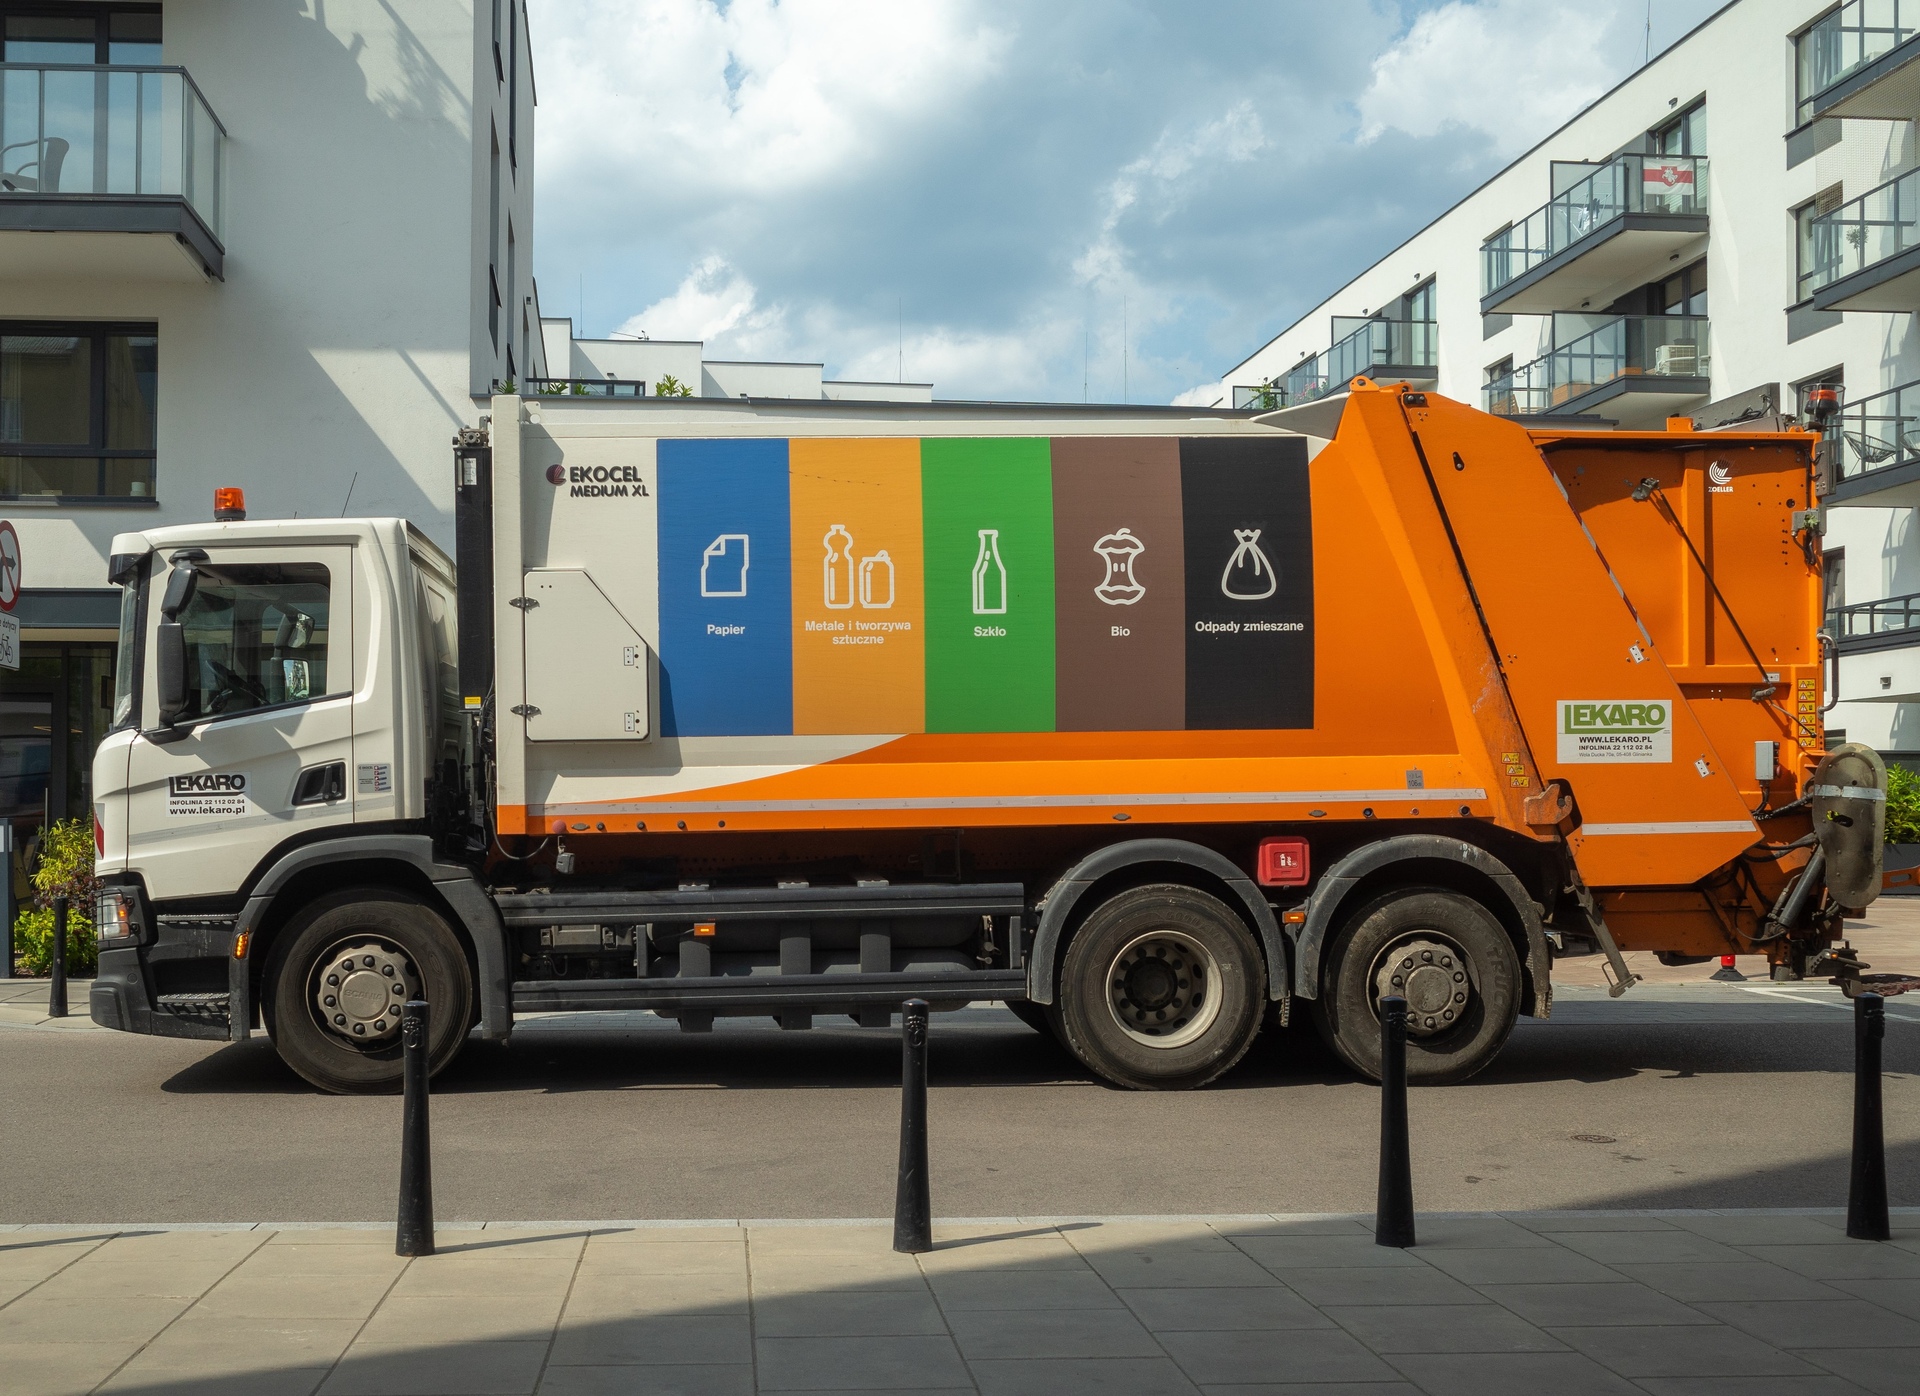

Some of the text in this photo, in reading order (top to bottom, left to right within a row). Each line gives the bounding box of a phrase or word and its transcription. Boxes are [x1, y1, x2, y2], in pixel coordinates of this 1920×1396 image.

[569, 466, 643, 483] EKOCEL
[570, 484, 650, 498] MEDIUM XL
[706, 624, 746, 637] Papier
[805, 620, 911, 632] Metale i tworzywa
[973, 626, 1007, 637] Szkło
[1110, 626, 1131, 637] Bio
[1194, 620, 1304, 634] Odpady zmieszane
[832, 635, 885, 645] sztuczne
[1564, 704, 1666, 734] LEKARO
[168, 774, 246, 797] LEKARO
[169, 805, 246, 815] www.lekaro.pl
